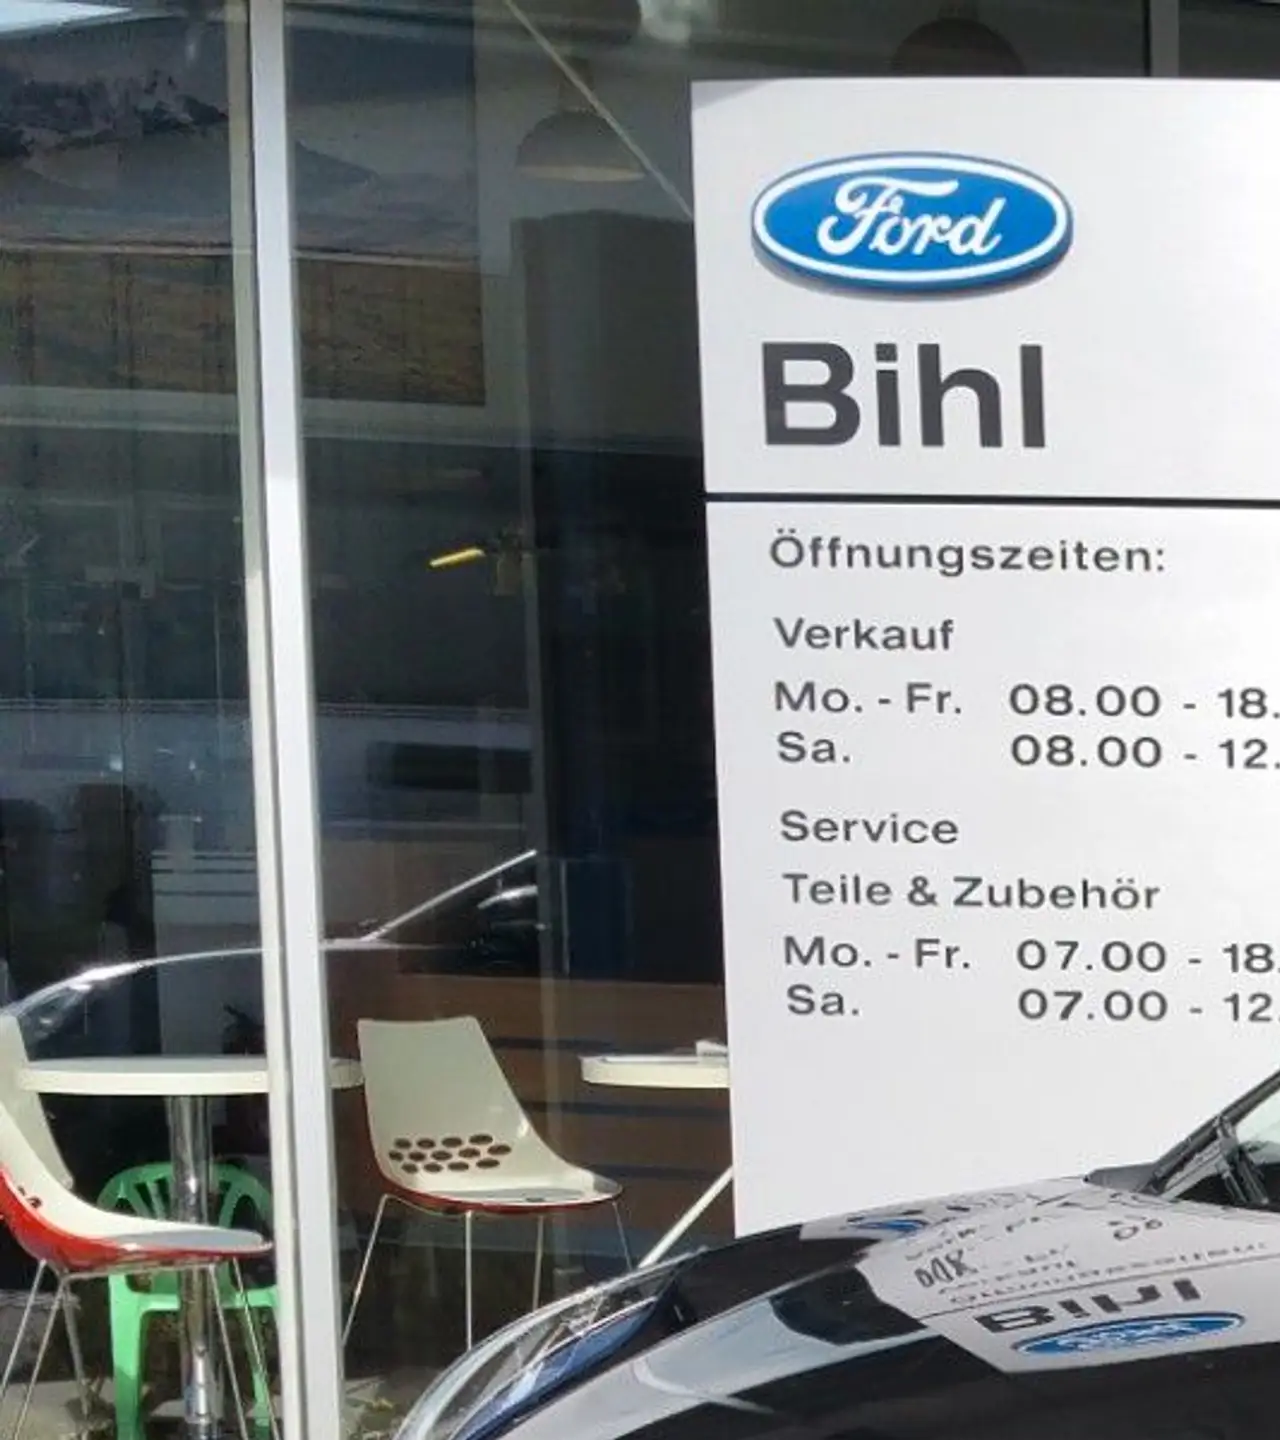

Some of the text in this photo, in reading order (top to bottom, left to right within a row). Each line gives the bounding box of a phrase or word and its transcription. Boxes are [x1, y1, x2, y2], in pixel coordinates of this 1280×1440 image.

[816, 176, 1007, 256] Ford
[762, 342, 1045, 448] Bihl
[769, 528, 1165, 577] Öffnungszeiten:
[774, 617, 954, 652] Verkauf
[775, 681, 863, 714] Mo.
[906, 681, 962, 715] Fr.
[1008, 683, 1162, 718] 08.00
[777, 730, 851, 764] Sa.
[1010, 734, 1163, 769] 08.00
[780, 809, 959, 845] Service
[782, 872, 1161, 910] Teile & Zubehör
[784, 935, 872, 968] Mo.
[914, 937, 970, 969] Fr.
[1016, 938, 1167, 973] 07.00
[786, 983, 859, 1016] Sa.
[1018, 987, 1169, 1022] 07.00
